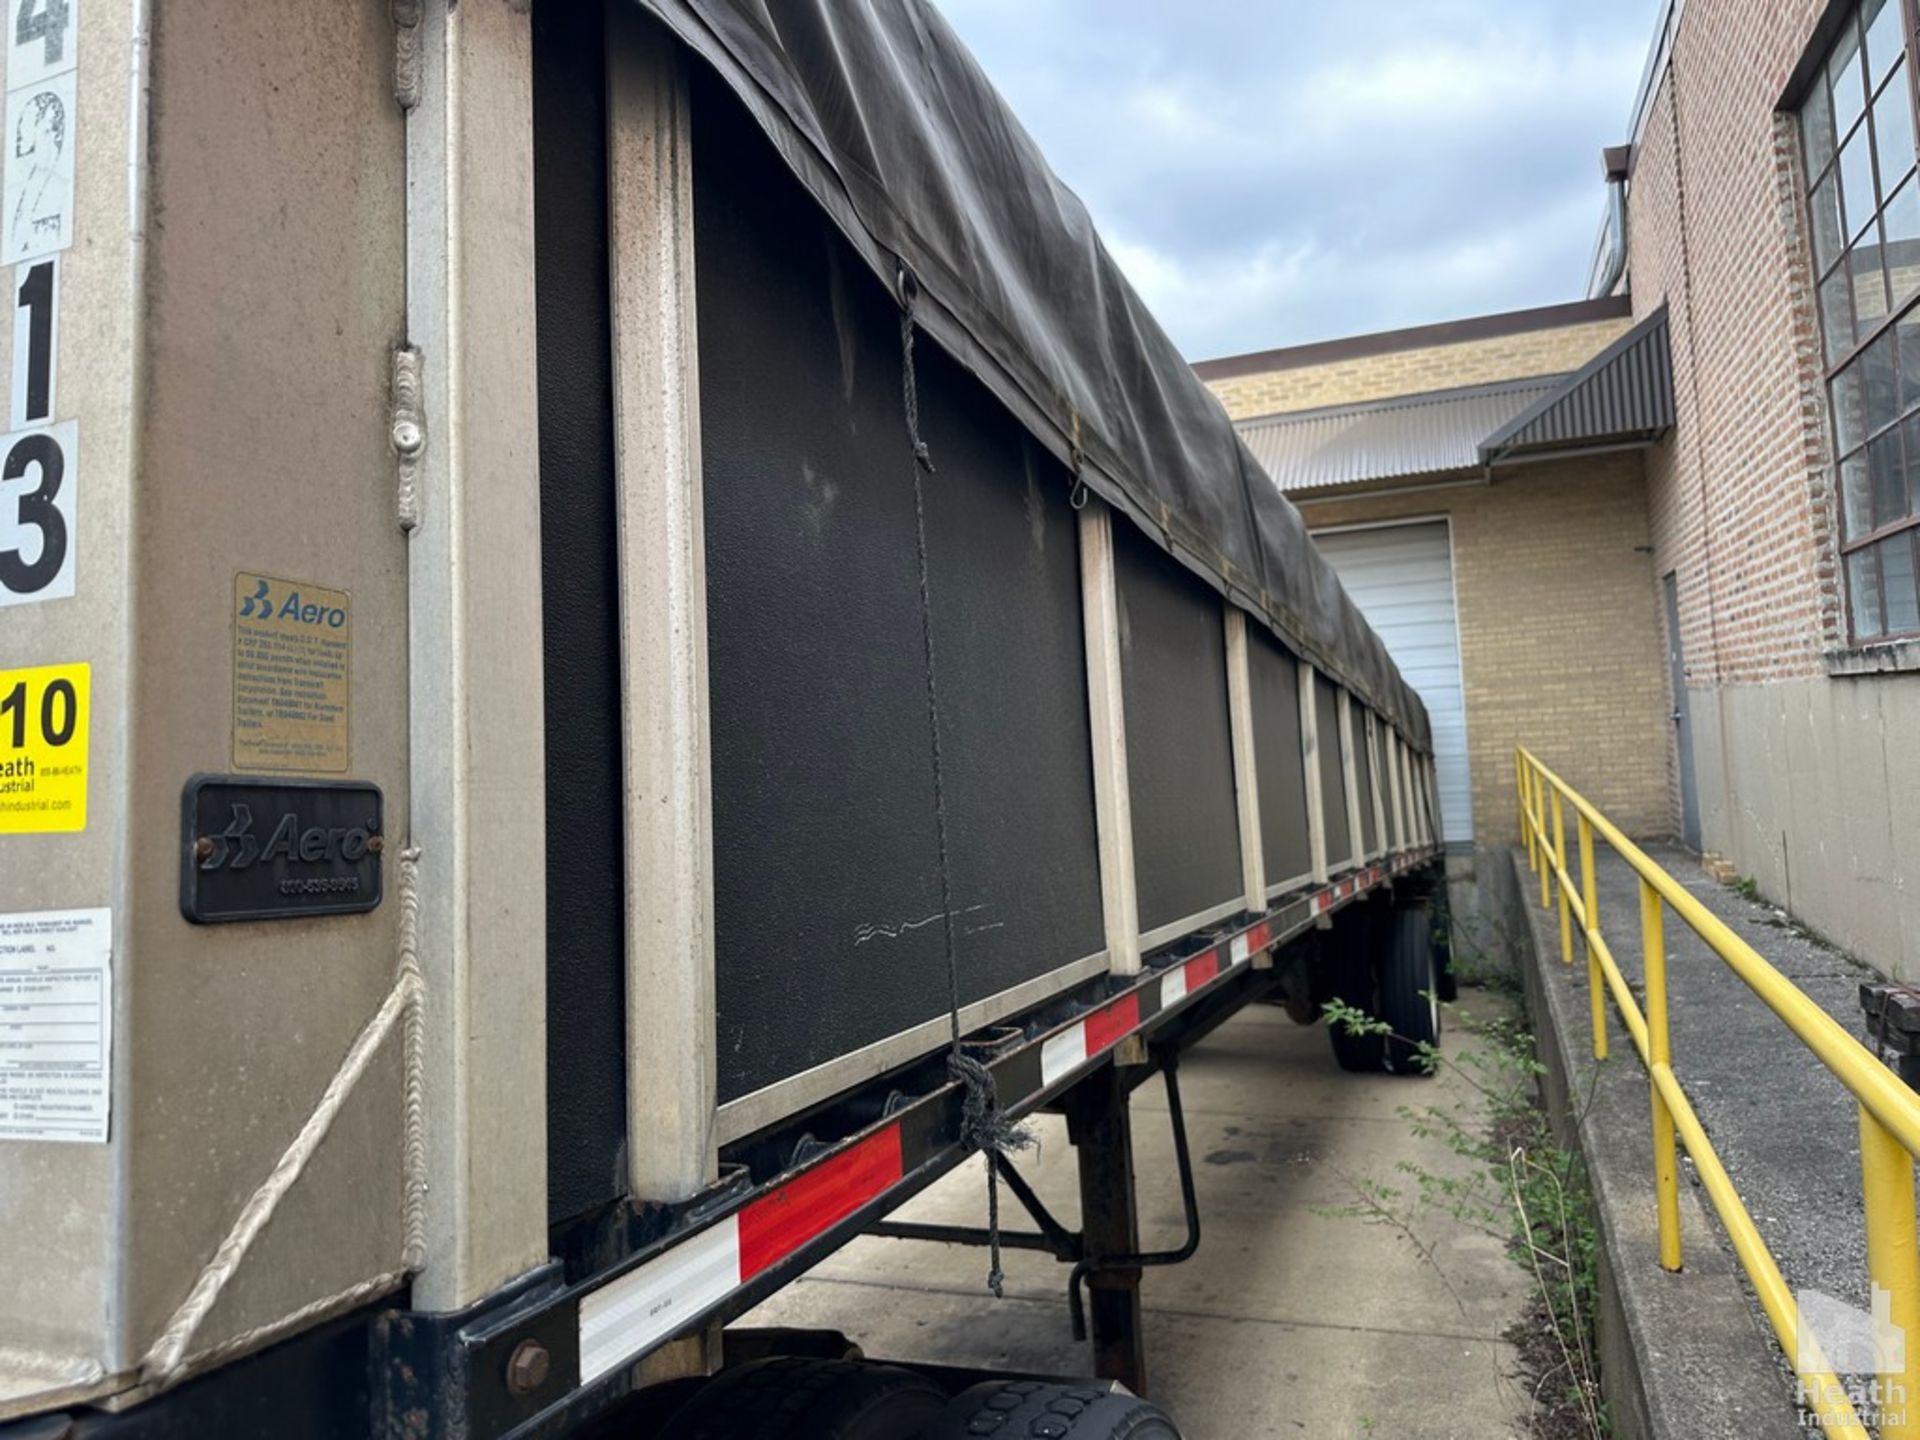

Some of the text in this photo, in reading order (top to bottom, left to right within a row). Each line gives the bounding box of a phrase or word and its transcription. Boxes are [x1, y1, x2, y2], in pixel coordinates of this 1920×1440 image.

[16, 0, 69, 66] 4
[18, 260, 54, 421] 1
[0, 433, 67, 593] 3
[278, 592, 346, 628] Aero
[1, 679, 77, 748] 10
[260, 813, 369, 862] Aero
